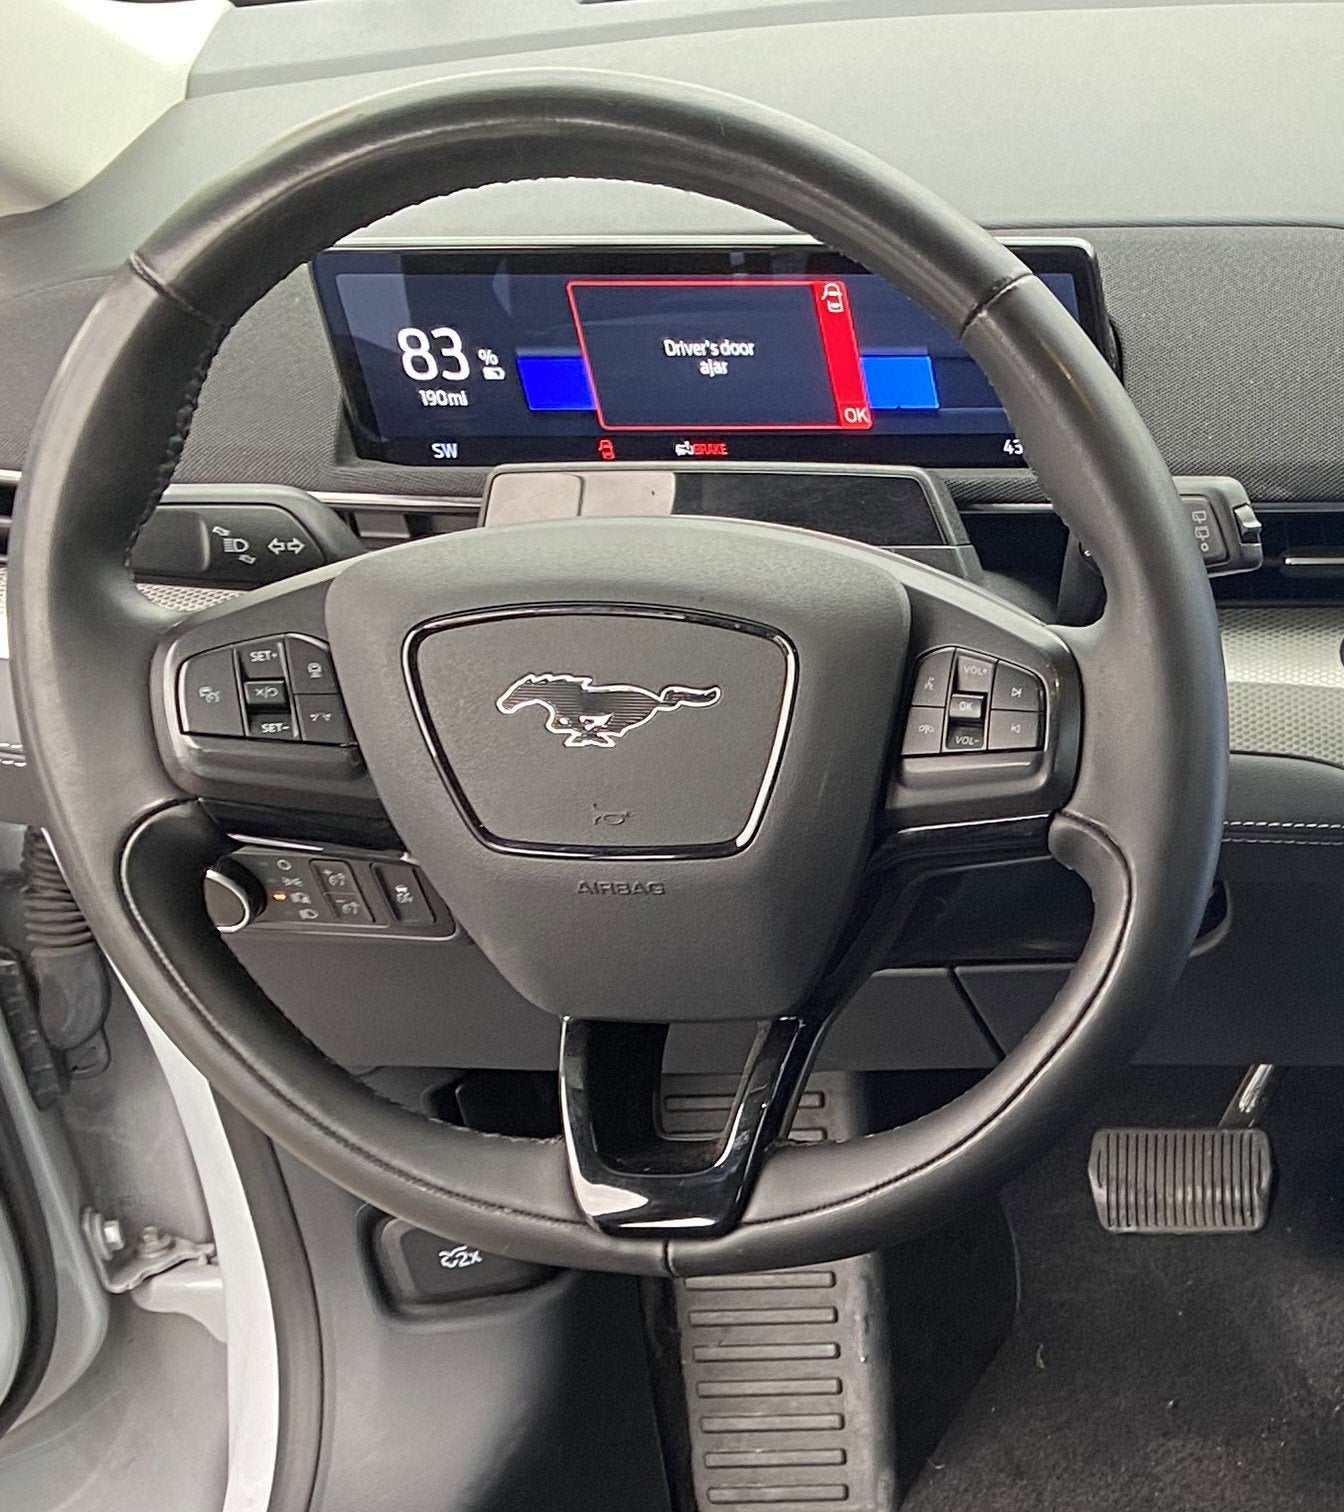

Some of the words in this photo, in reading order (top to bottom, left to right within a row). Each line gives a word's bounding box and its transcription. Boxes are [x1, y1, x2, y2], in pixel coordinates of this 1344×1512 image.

[663, 338, 720, 357] Driver's
[720, 338, 755, 356] door
[699, 358, 729, 378] ajar
[843, 407, 870, 424] OK
[431, 442, 458, 459] SW
[692, 443, 729, 456] BRAKE
[250, 650, 278, 662] SET+
[963, 664, 988, 676] VOL+
[959, 701, 972, 712] OK
[261, 722, 290, 733] SET-
[955, 734, 980, 745] VOL-
[578, 881, 666, 896] AIRBAG
